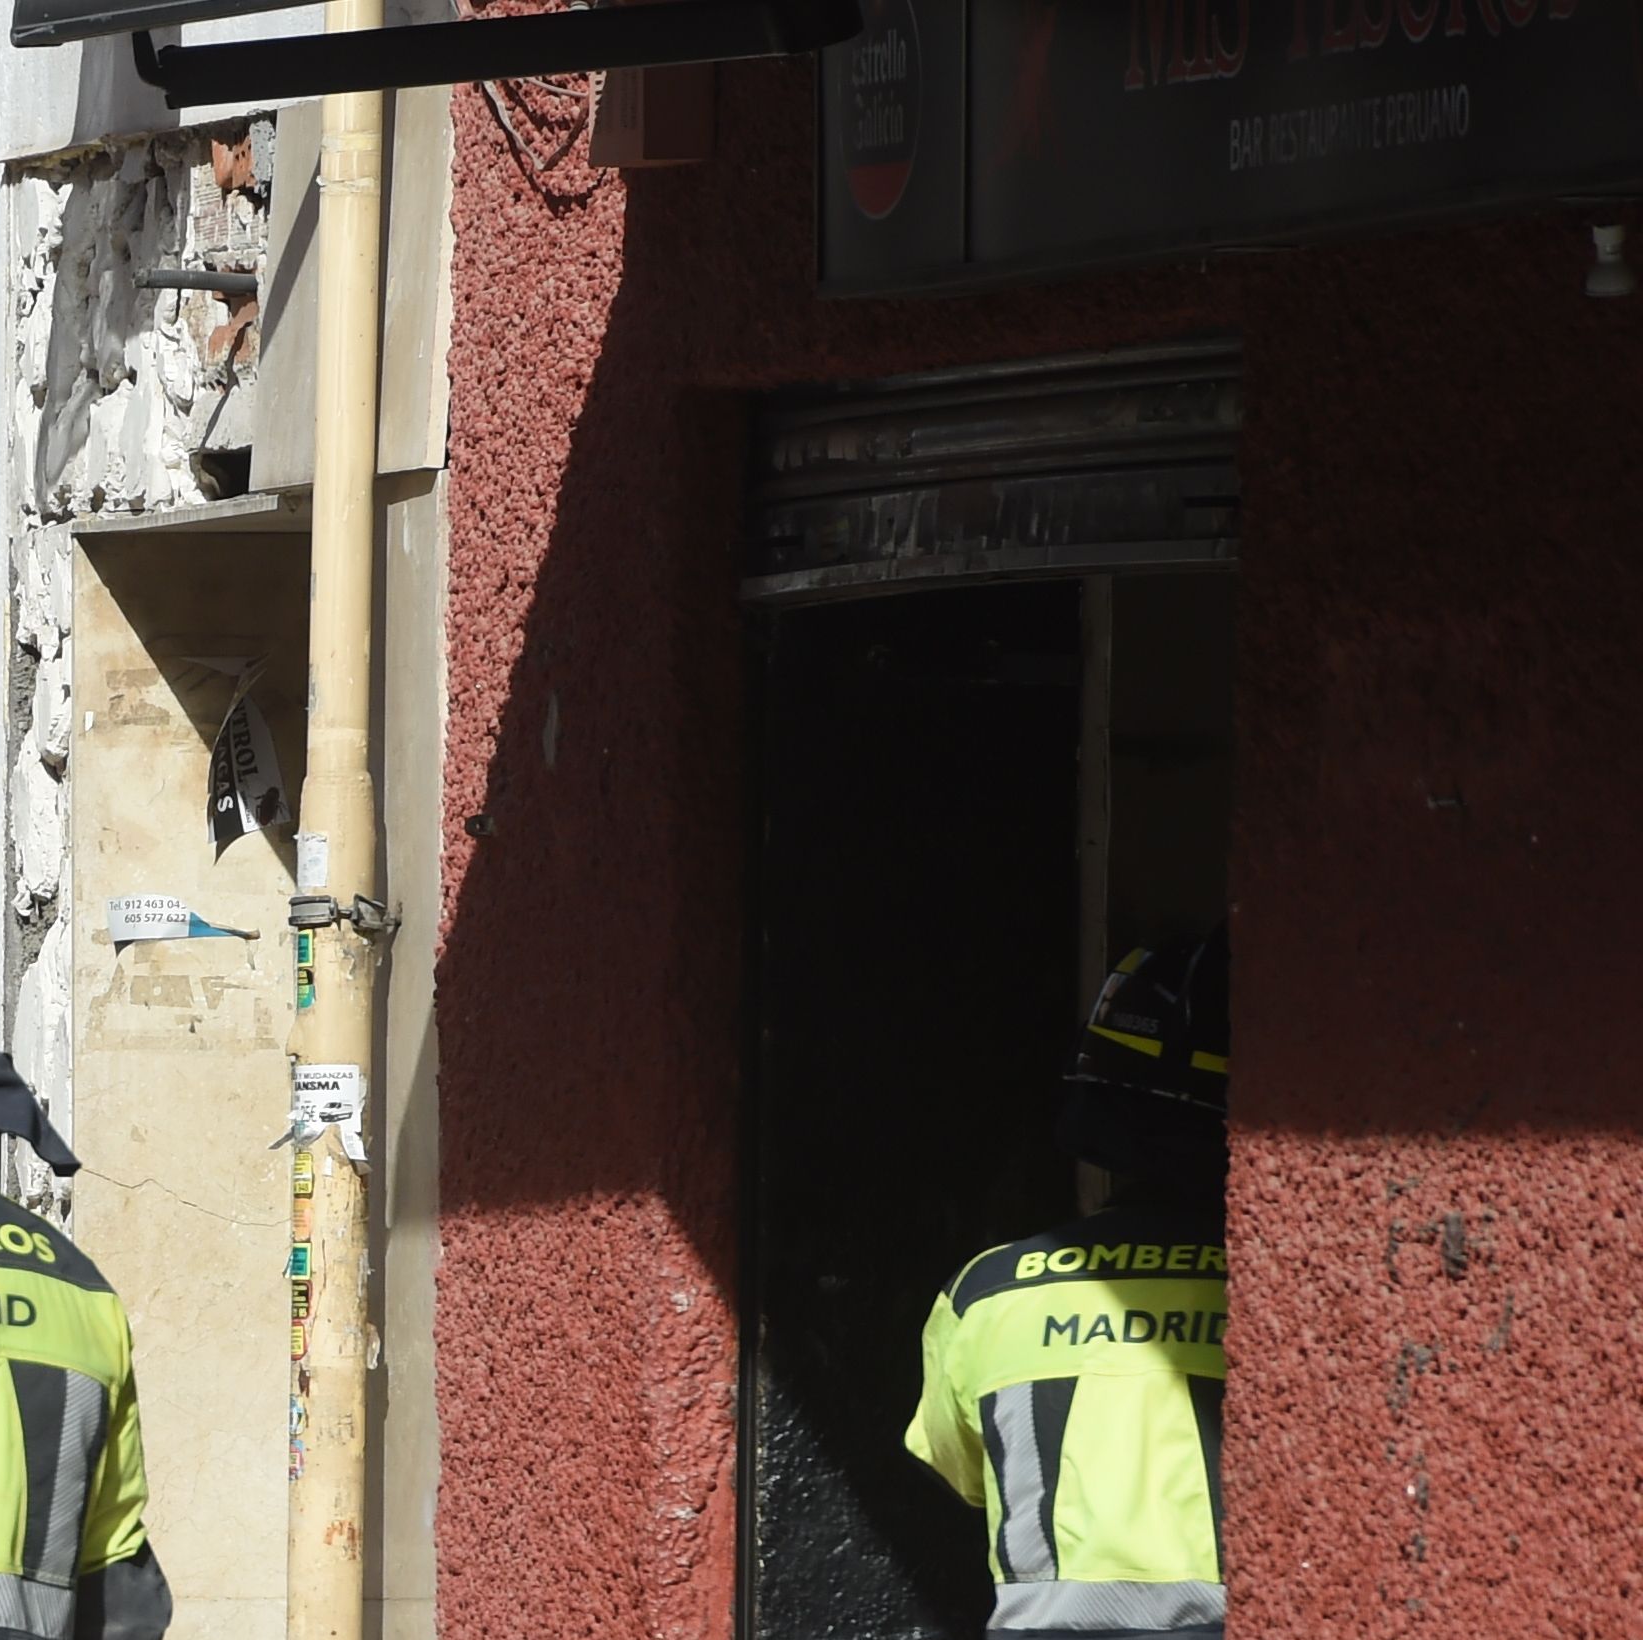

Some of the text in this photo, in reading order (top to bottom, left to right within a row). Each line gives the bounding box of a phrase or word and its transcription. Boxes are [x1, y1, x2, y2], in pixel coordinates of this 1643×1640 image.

[1229, 83, 1470, 171] BAR RESTAURANTE PERUANO
[124, 899, 142, 910] 912
[145, 899, 164, 909] 463
[124, 913, 187, 924] 605 577 622
[303, 1071, 354, 1080] MUDANZAS
